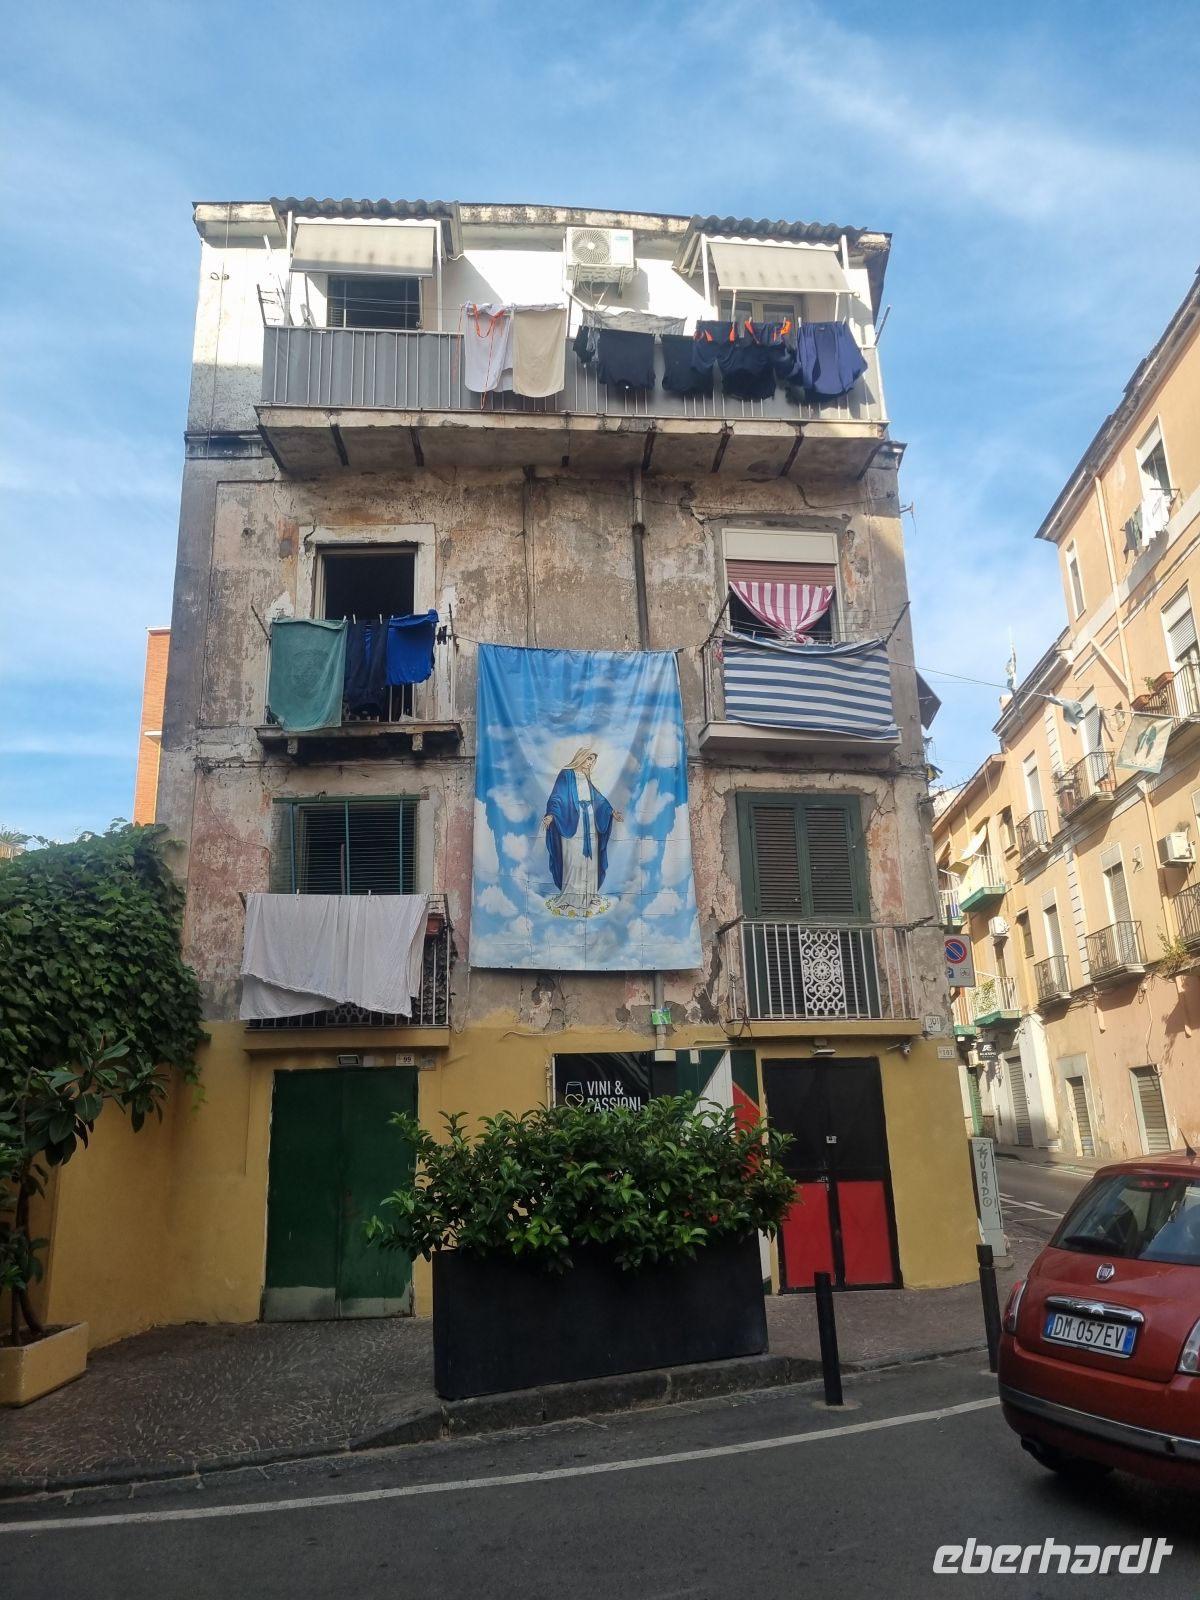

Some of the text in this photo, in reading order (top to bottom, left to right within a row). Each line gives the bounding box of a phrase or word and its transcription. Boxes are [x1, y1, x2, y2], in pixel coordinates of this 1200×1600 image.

[587, 1080, 624, 1096] VINI &
[1053, 1316, 1124, 1349] DM 057EV
